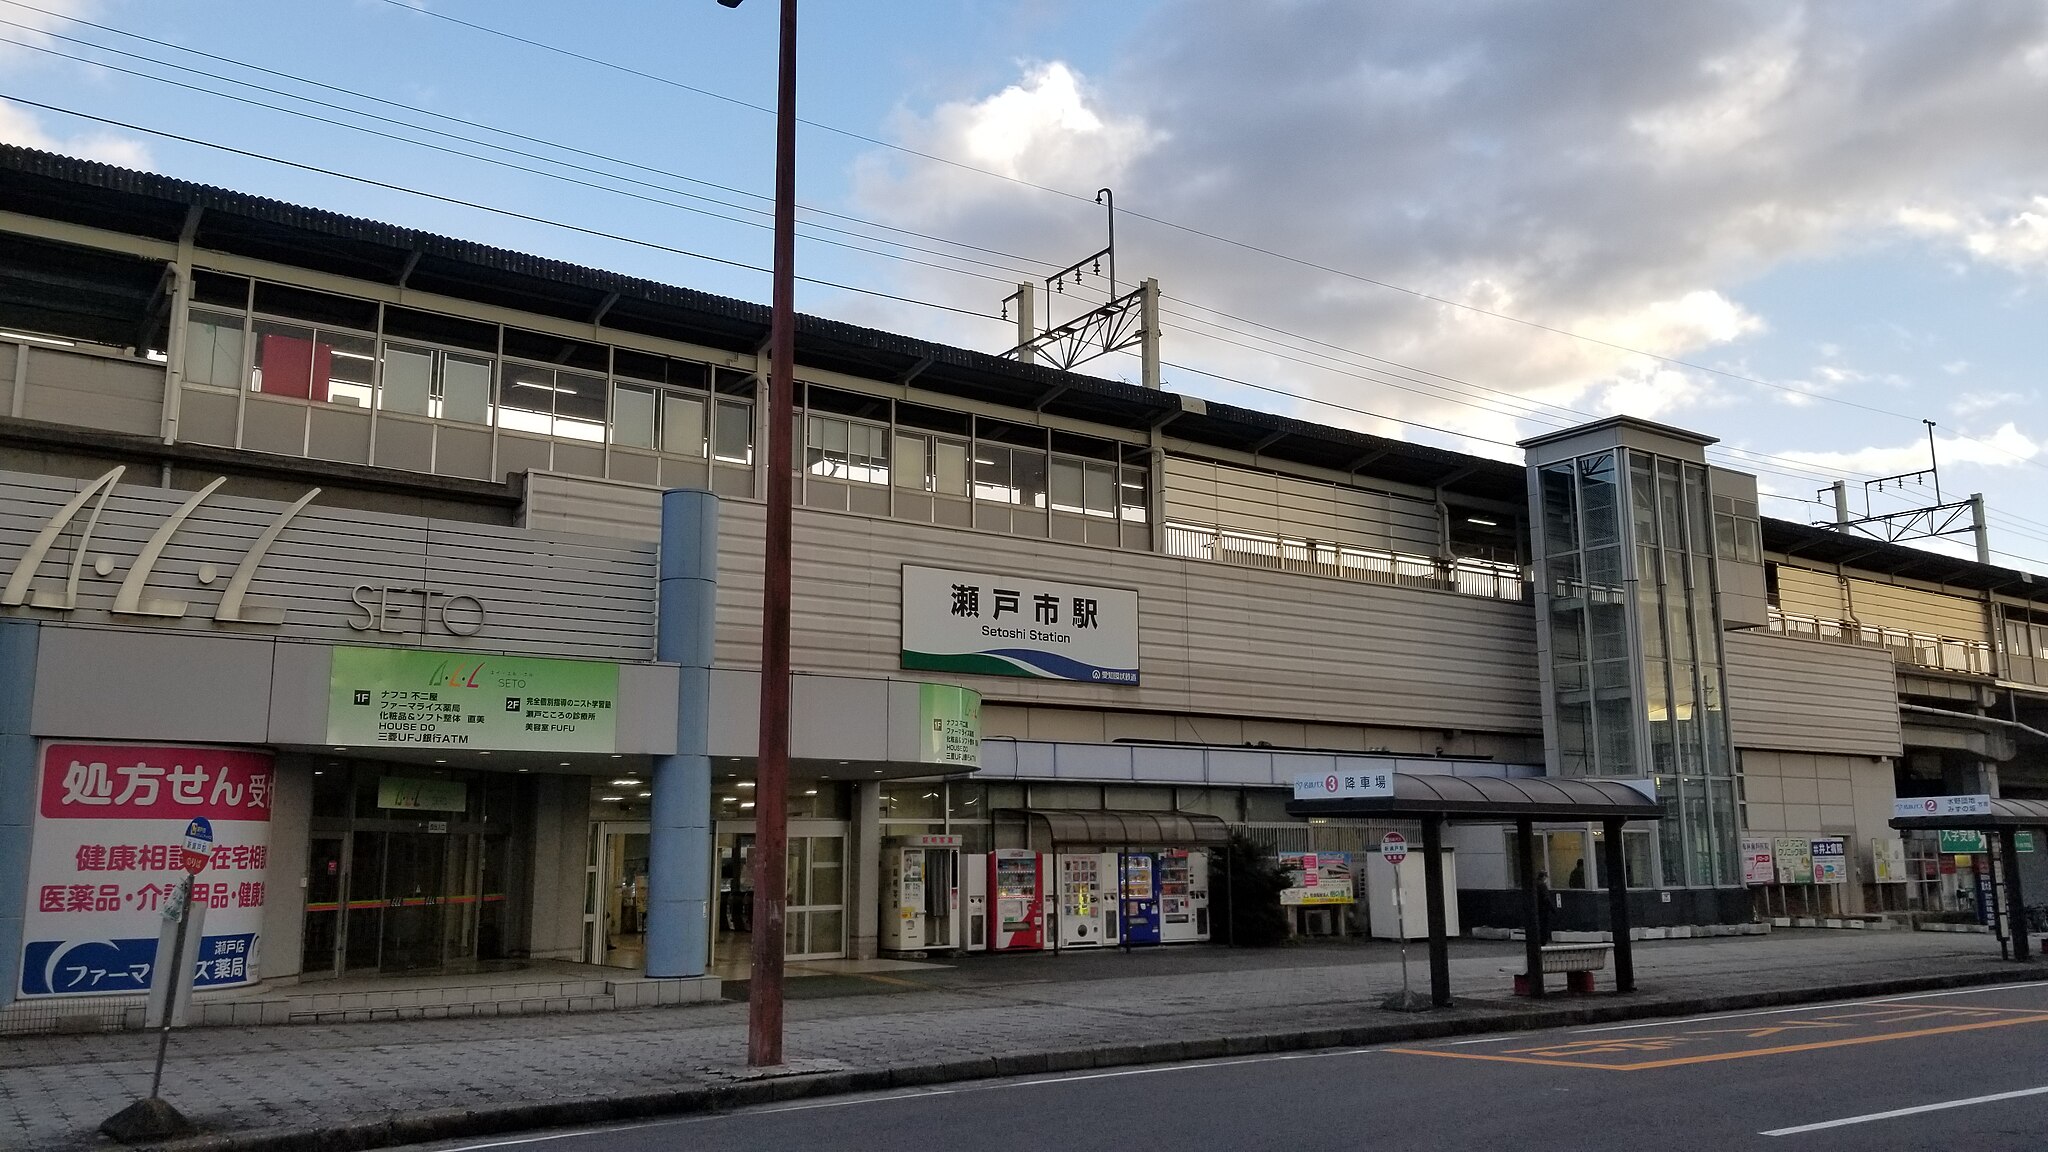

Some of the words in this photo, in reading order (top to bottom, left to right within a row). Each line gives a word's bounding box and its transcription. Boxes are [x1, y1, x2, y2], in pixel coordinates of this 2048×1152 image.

[348, 584, 486, 637] SETO
[951, 583, 1098, 630] 瀬戸市駅
[981, 625, 1026, 640] Setoshi
[1029, 630, 1071, 644] Station
[498, 678, 527, 689] SETO
[355, 692, 370, 704] 1F
[381, 690, 408, 699] ナフコ
[411, 691, 438, 701] 不二屋
[380, 701, 461, 713] ファーマライズ薬局
[506, 699, 520, 711] 2F
[378, 722, 417, 731] HOUSE
[420, 723, 436, 732] DO
[525, 722, 549, 732] 美容室
[551, 724, 575, 732] FUFU
[1344, 775, 1386, 791] 降車場
[214, 940, 245, 955] 瀬戸店
[66, 957, 244, 987] ファーマズ薬局
